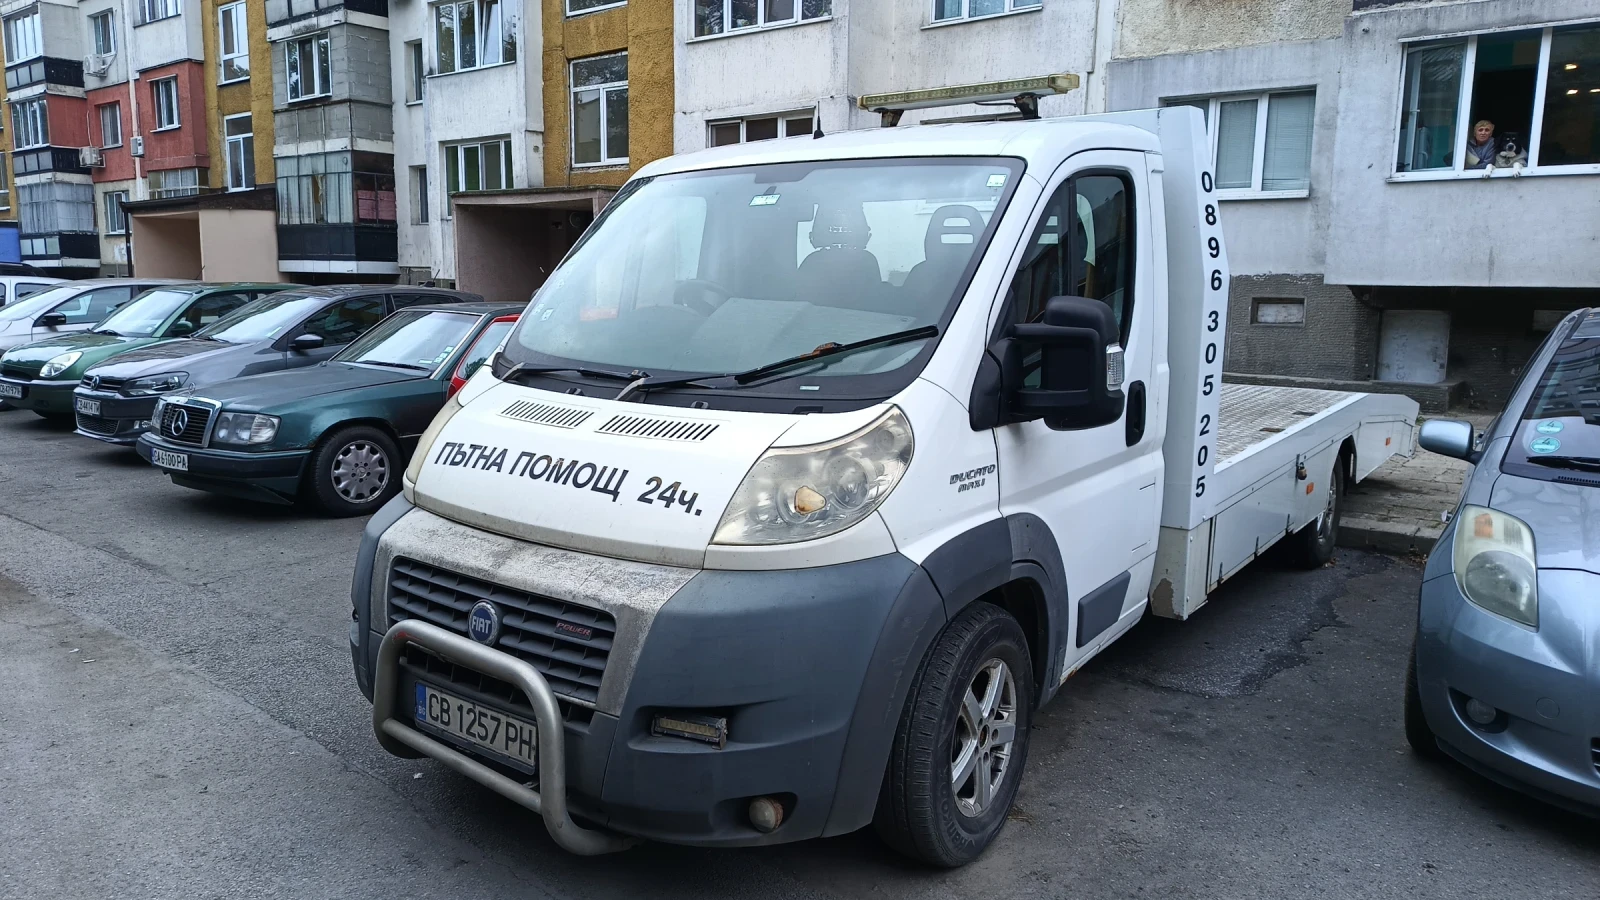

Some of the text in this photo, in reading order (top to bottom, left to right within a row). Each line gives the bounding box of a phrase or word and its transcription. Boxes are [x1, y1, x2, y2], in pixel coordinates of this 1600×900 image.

[1195, 171, 1223, 498] 0896 305 205
[434, 442, 703, 516] ПЪТНА ПОМОЩ 24ч.
[949, 464, 996, 485] DUCATO
[958, 478, 985, 493] MAXI
[471, 615, 492, 634] FIAT
[556, 622, 591, 637] POWER
[456, 703, 502, 745] 1257
[505, 721, 533, 760] PH
